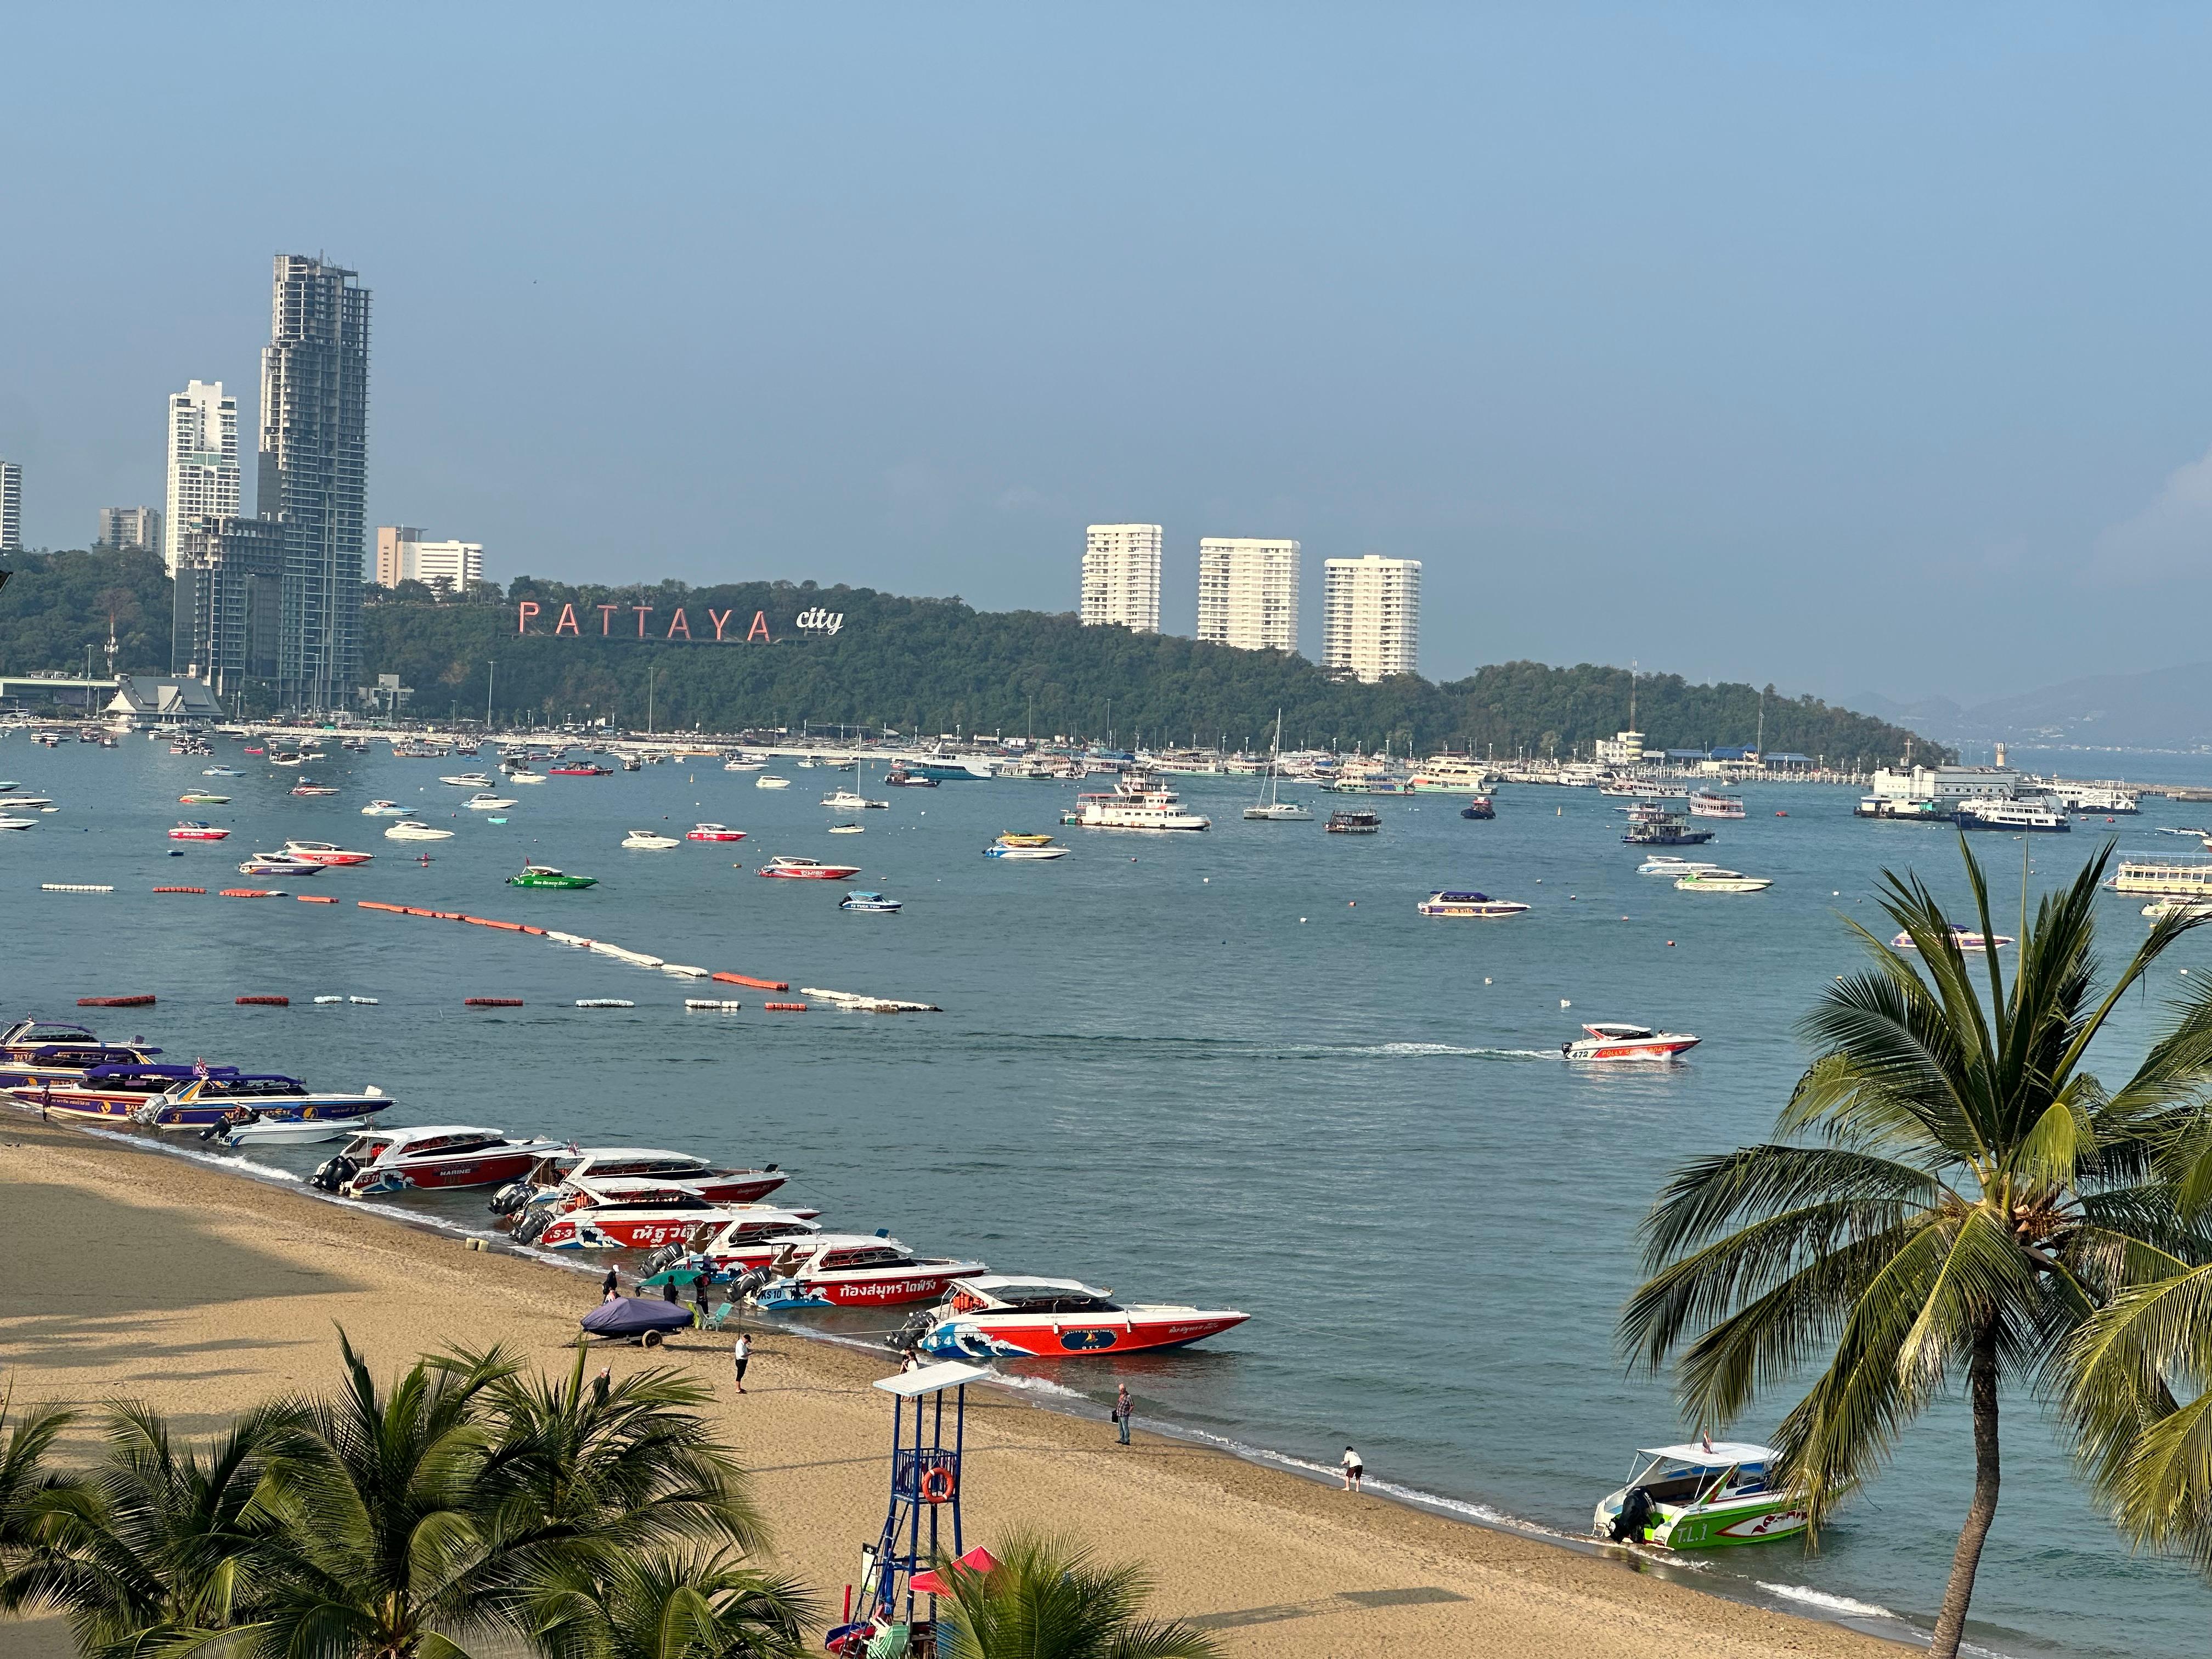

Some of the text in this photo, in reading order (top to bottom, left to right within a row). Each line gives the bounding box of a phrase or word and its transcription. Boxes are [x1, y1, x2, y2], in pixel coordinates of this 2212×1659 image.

[520, 602, 844, 642] PATTAYA city
[173, 1112, 180, 1122] 3
